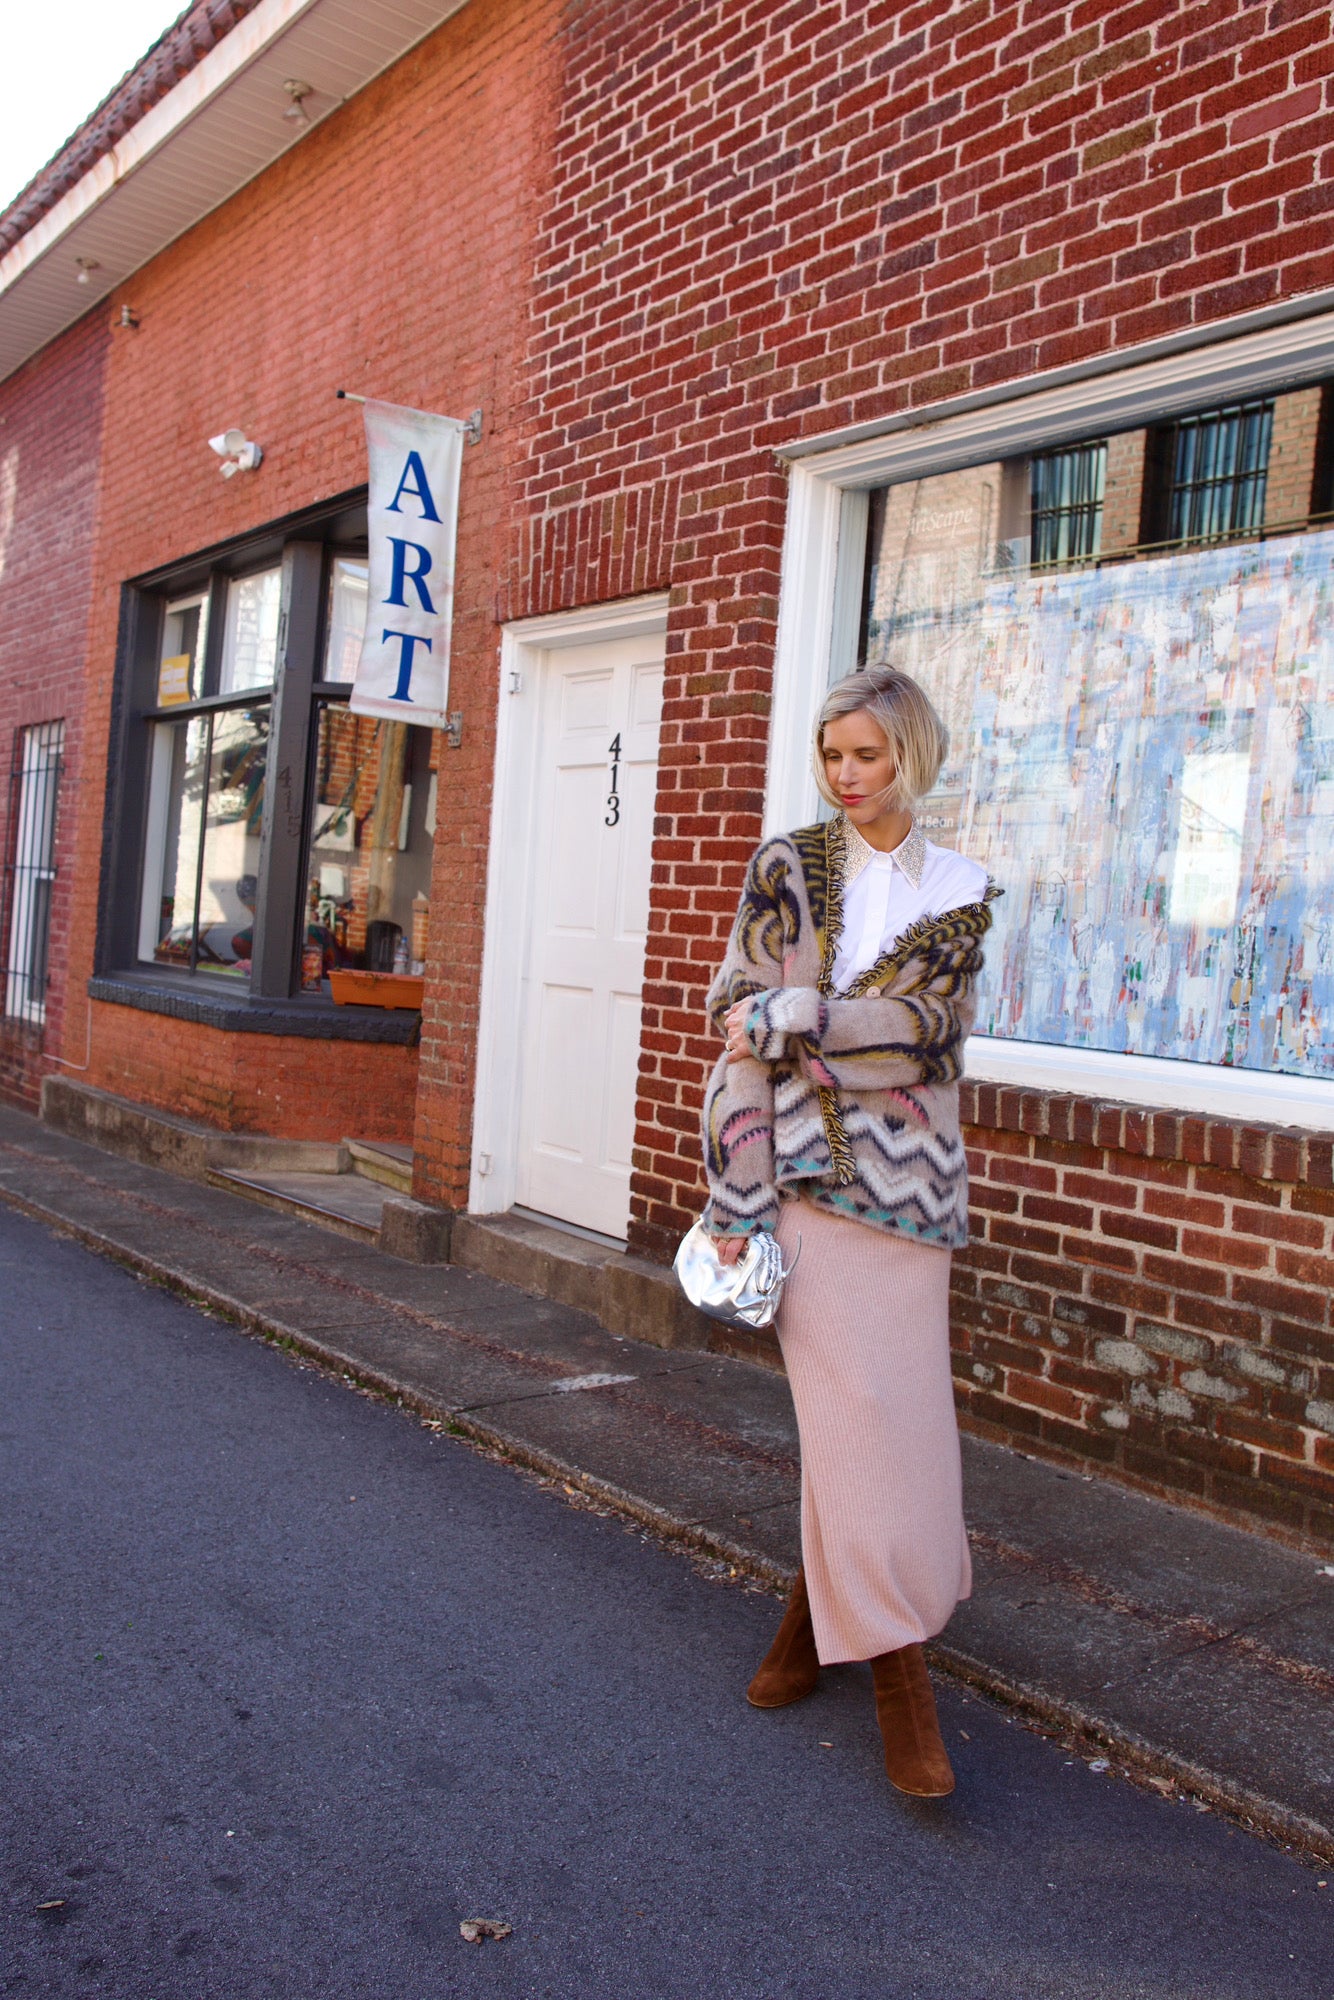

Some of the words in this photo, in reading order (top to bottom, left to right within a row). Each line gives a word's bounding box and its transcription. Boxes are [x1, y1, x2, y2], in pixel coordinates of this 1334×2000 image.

[382, 450, 442, 702] ART
[277, 766, 301, 837] 415
[605, 733, 622, 827] 413
[926, 815, 954, 828] Bean
